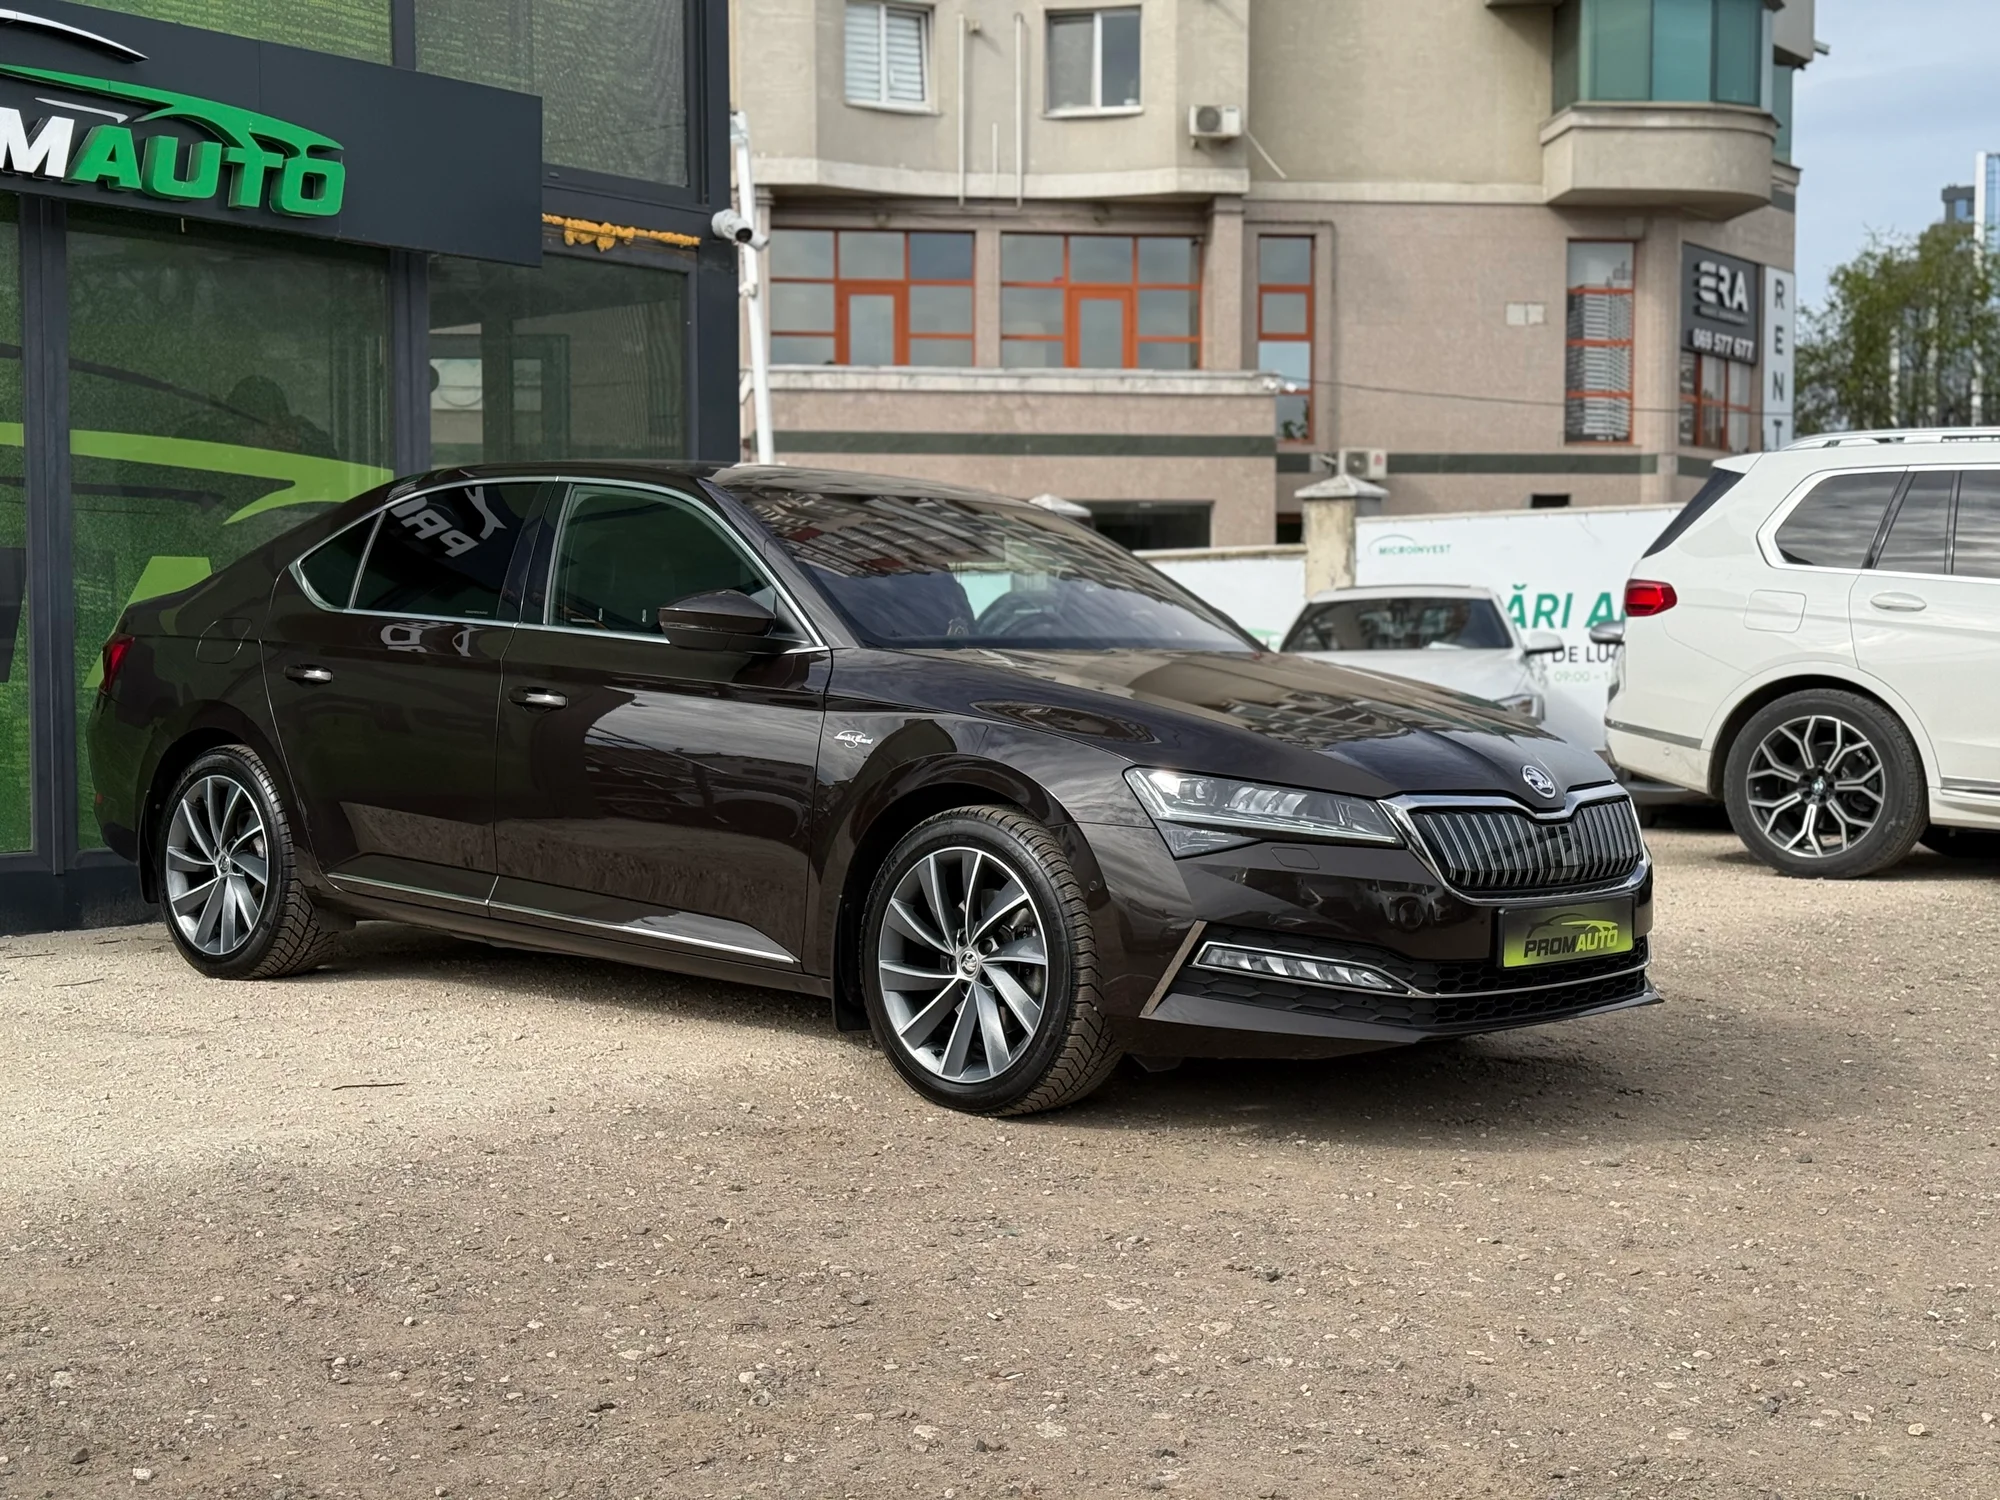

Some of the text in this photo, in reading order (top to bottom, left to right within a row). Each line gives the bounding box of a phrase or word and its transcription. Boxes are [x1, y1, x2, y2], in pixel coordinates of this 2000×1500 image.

[1699, 260, 1749, 313] ERA
[1713, 333, 1733, 355] 577
[1733, 338, 1754, 359] 677
[1773, 278, 1786, 448] RENT
[1379, 544, 1451, 556] MICROINVEST
[1584, 592, 1625, 629] A
[1552, 646, 1578, 663] DE
[1524, 929, 1618, 958] PROMAUTO
